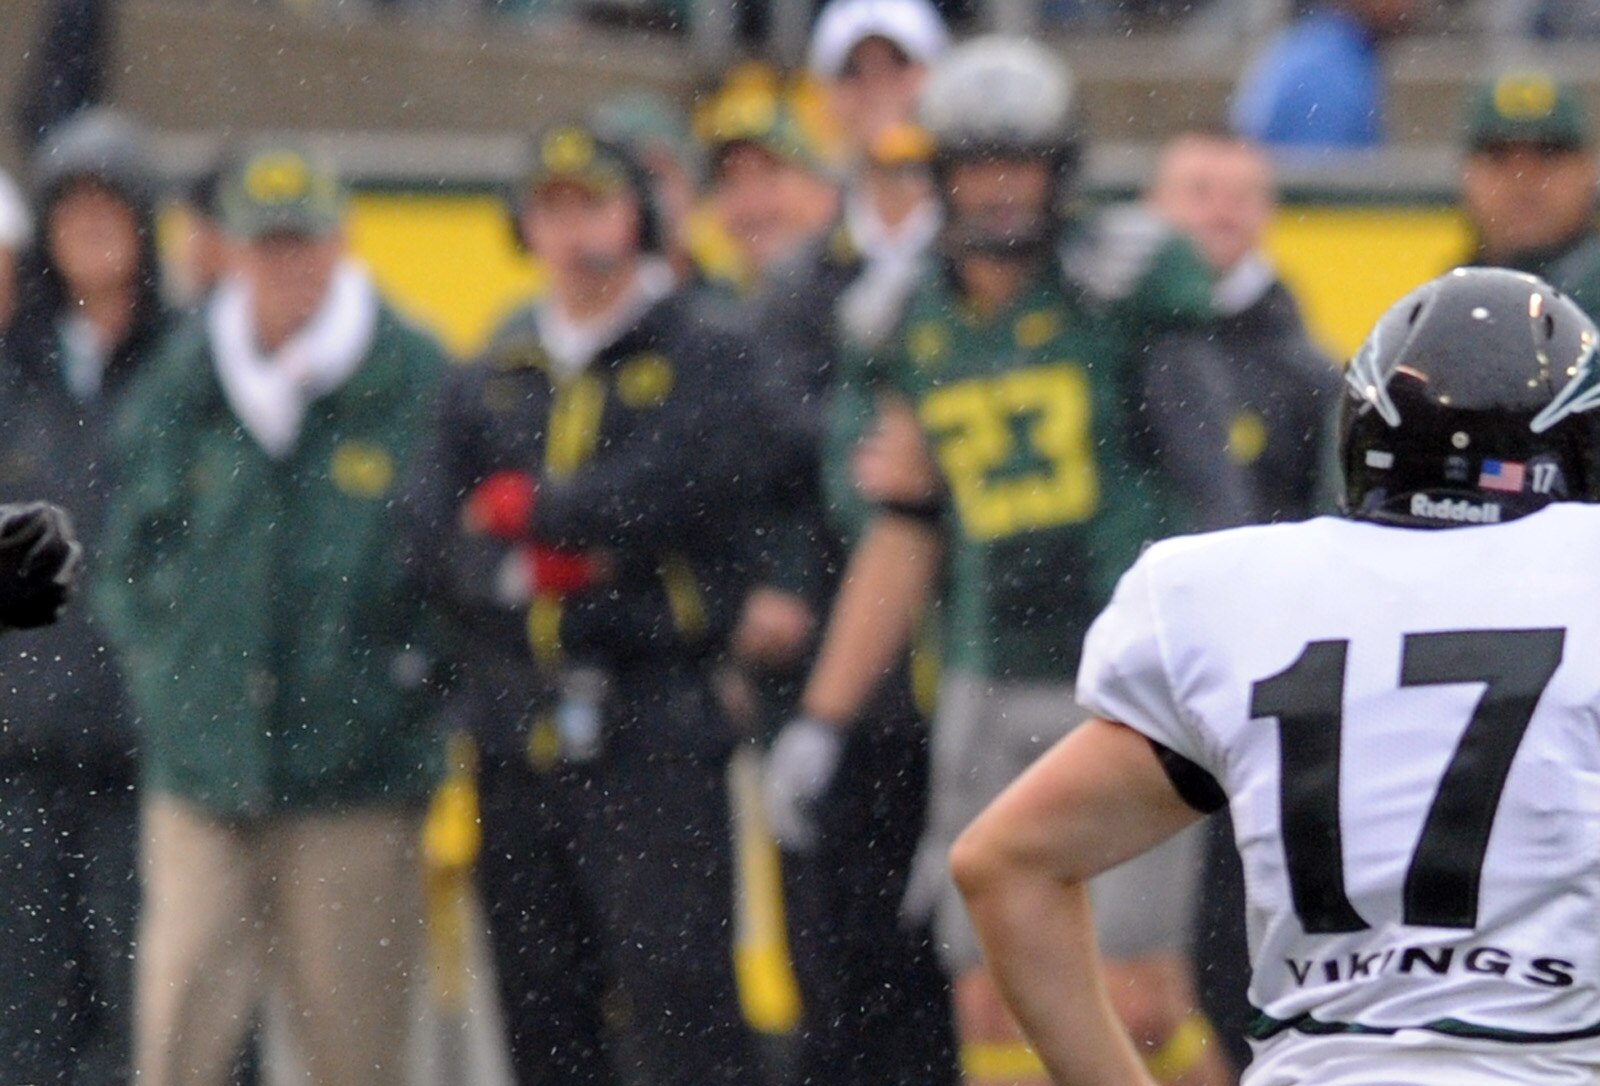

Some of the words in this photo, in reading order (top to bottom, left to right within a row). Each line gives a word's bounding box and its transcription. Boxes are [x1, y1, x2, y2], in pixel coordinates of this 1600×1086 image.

[920, 364, 1098, 540] 23
[1532, 462, 1558, 494] 17
[1411, 493, 1501, 523] Riddell
[1249, 626, 1567, 935] 17
[1285, 946, 1577, 989] VIKINGS
